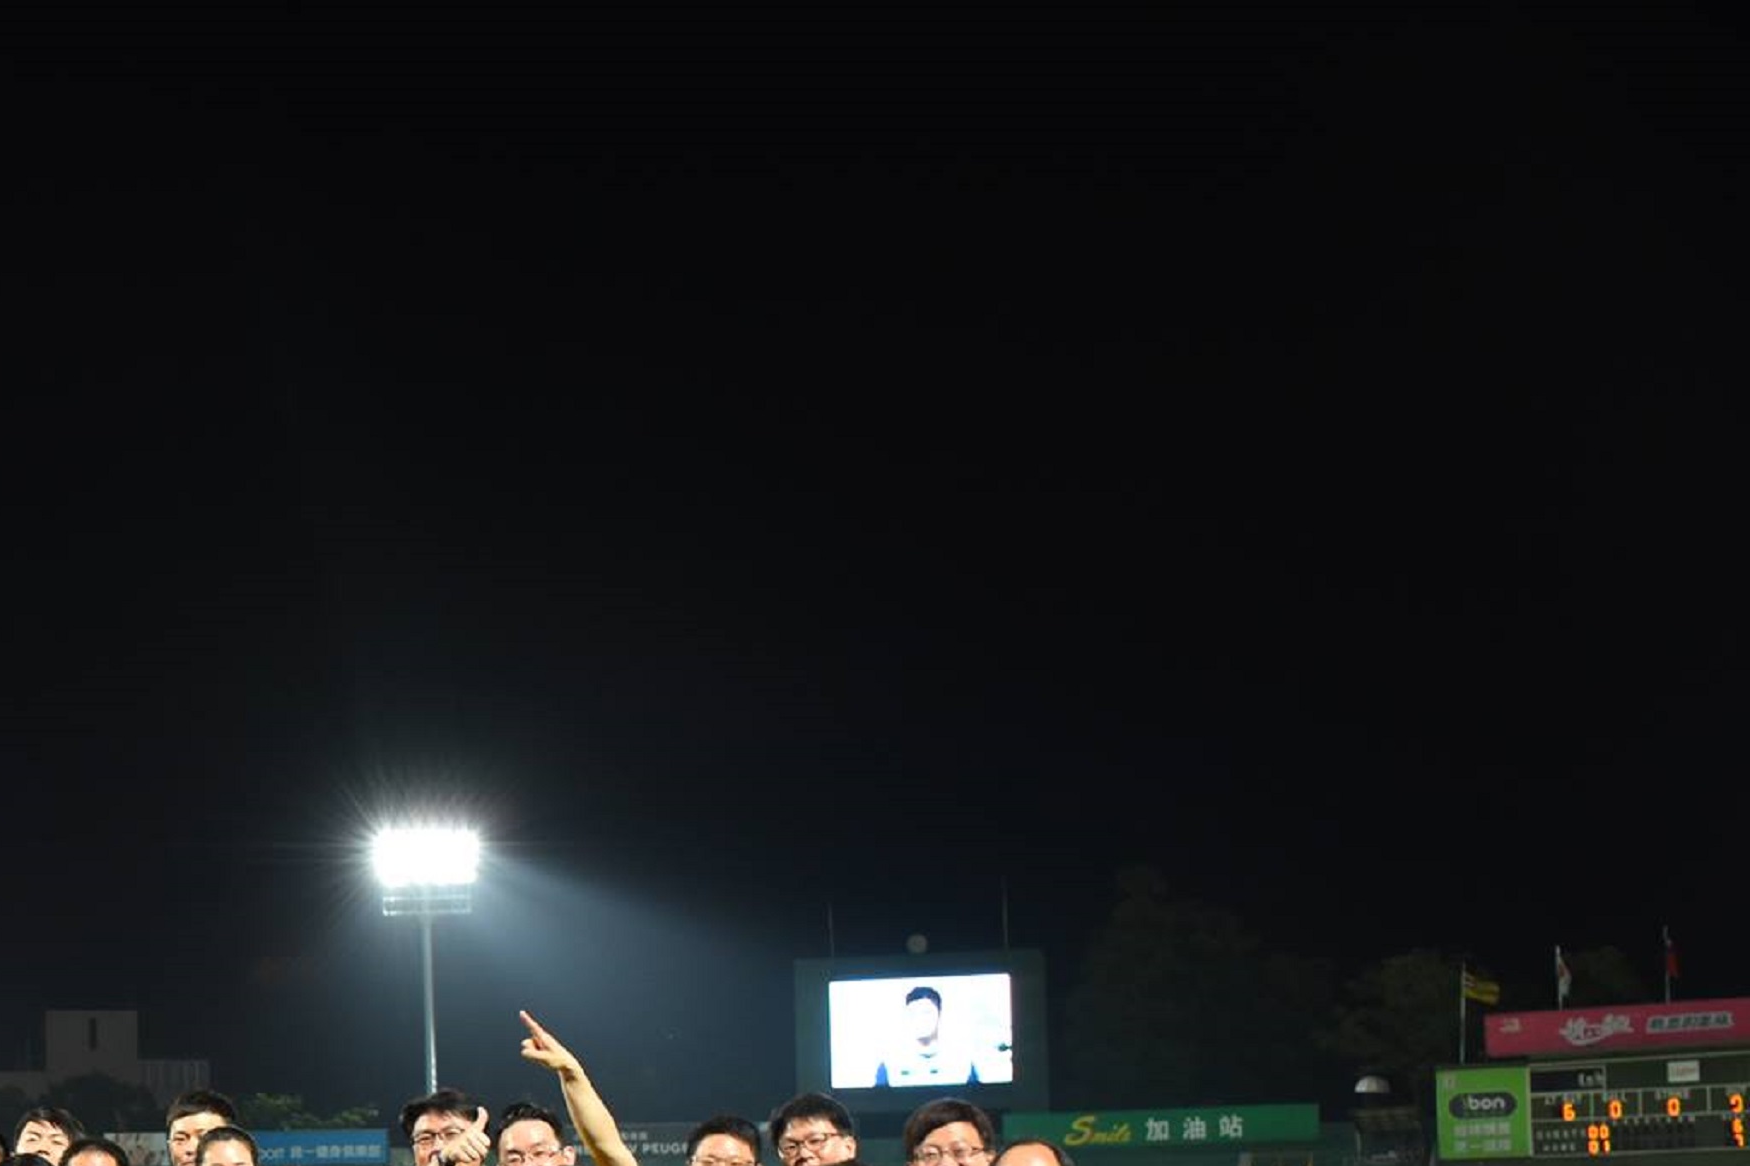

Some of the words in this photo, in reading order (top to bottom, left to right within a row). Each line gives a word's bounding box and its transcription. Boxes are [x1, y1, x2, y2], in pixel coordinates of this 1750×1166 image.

[1608, 1099, 1623, 1120] 0
[1666, 1096, 1681, 1117] 0
[1064, 1115, 1133, 1146] Smile
[1146, 1114, 1244, 1141] 加油站
